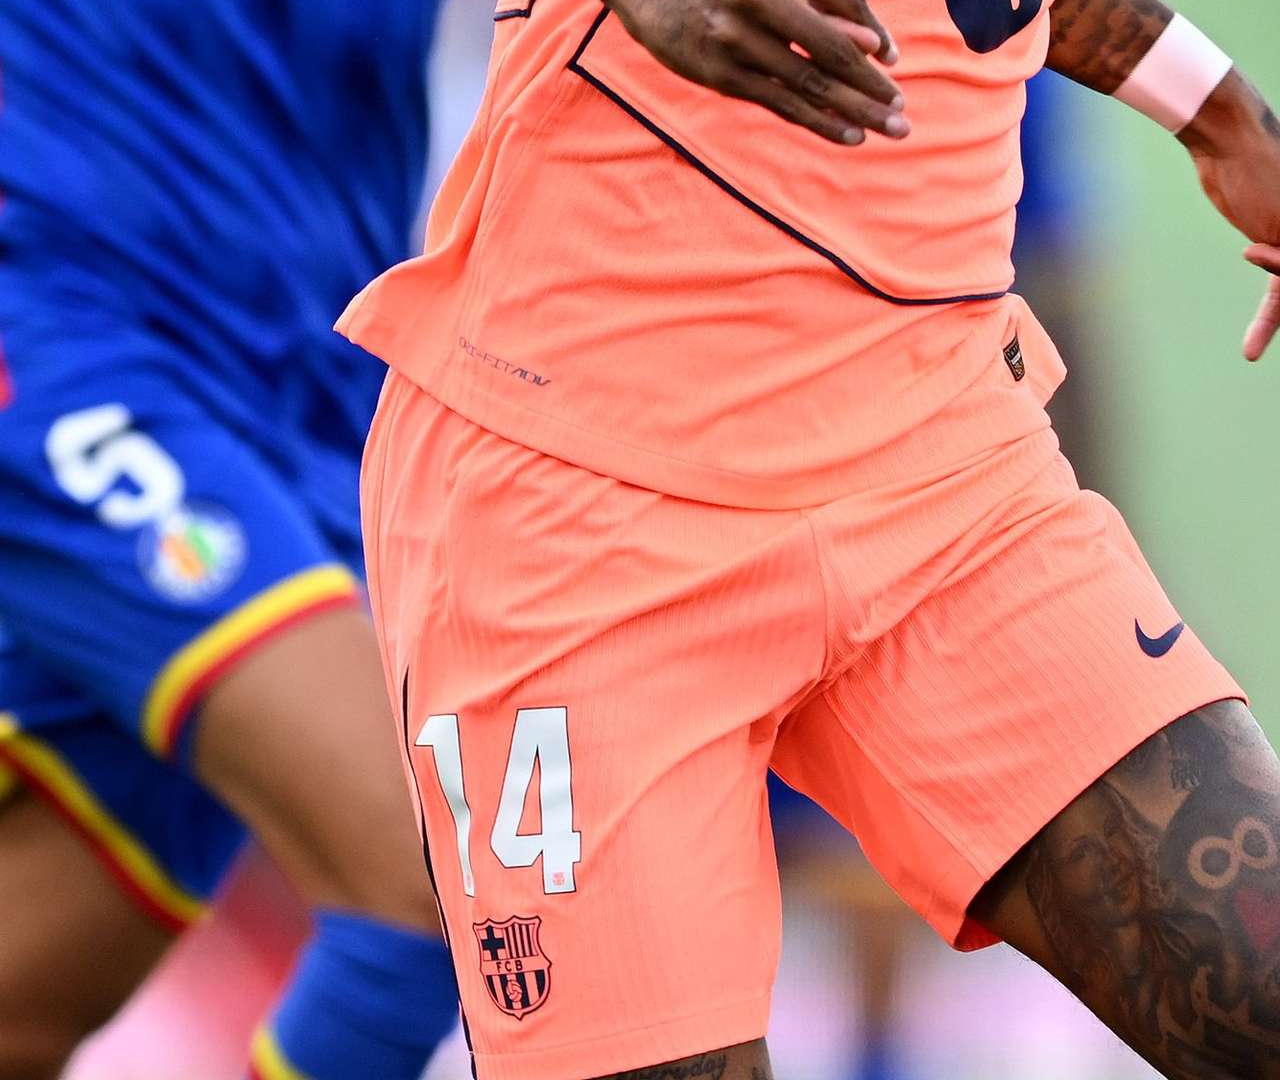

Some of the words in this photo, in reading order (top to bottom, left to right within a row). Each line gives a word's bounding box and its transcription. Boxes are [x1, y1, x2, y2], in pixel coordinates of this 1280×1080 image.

[45, 402, 186, 531] 5
[414, 706, 582, 898] 14
[495, 959, 524, 974] FCB
